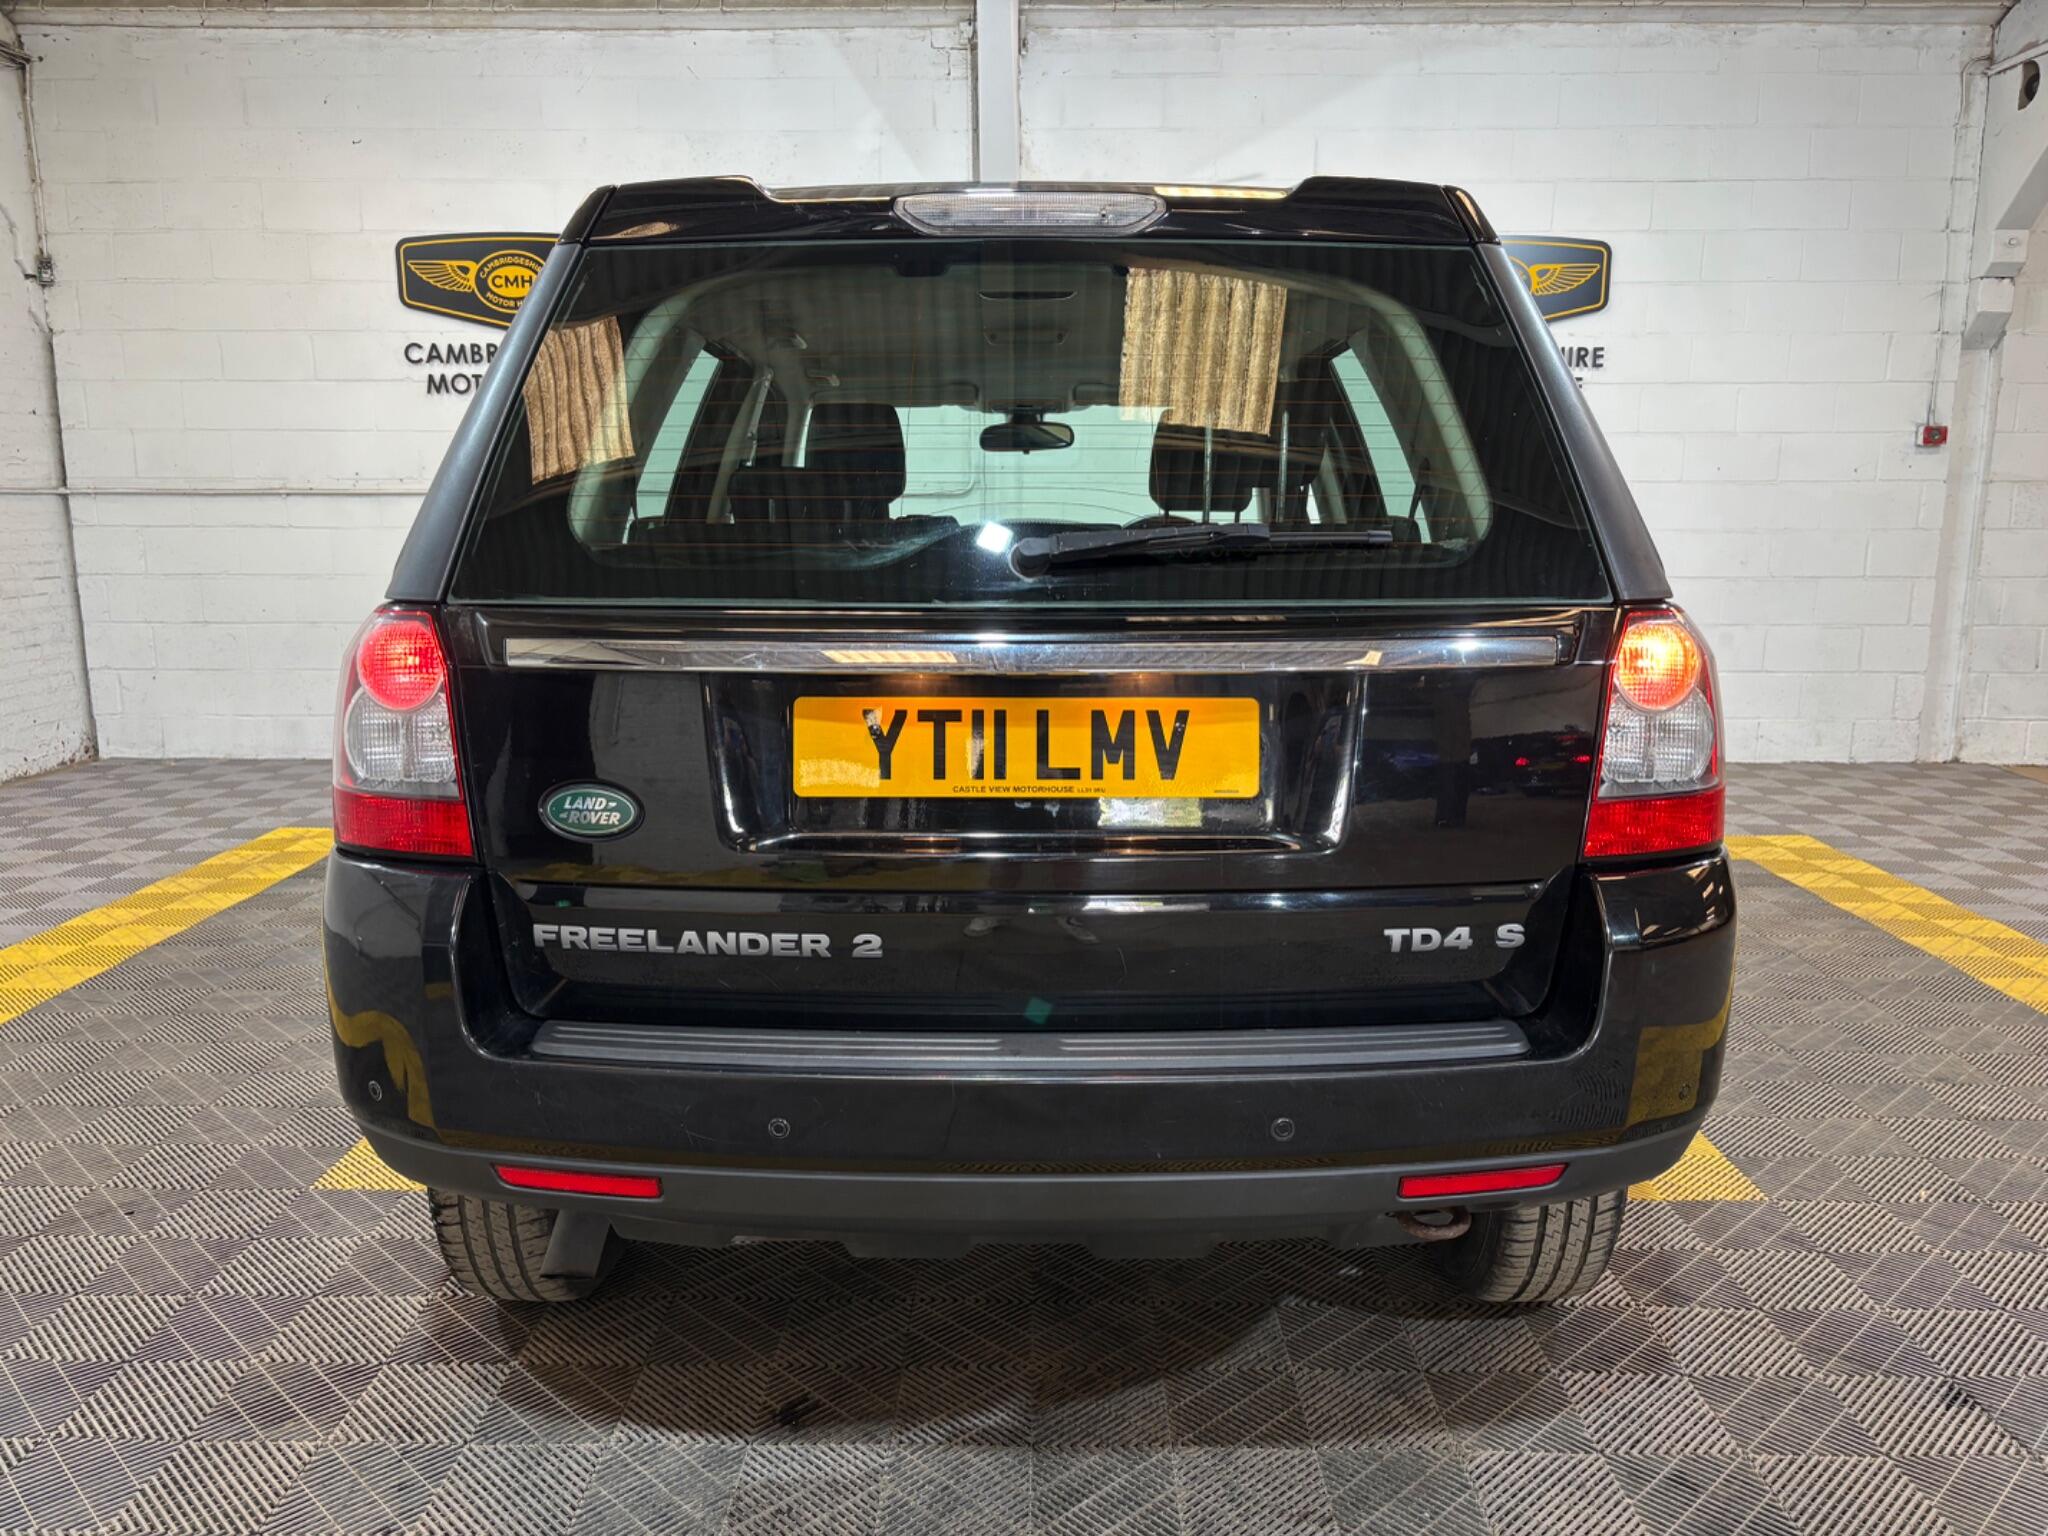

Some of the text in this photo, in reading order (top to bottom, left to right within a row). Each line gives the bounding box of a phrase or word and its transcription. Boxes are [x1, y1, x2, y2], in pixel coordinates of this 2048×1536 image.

[491, 274, 533, 289] CMH
[486, 291, 516, 307] MOTOR
[404, 342, 498, 364] CAMBR
[427, 373, 483, 395] MOT
[1036, 709, 1190, 780] LMV
[952, 785, 986, 793] CASTLE
[988, 785, 1011, 793] VIEW
[1012, 785, 1074, 793] MOTORHOUSE
[563, 796, 608, 810] LAND
[567, 810, 621, 825] ROVER
[533, 923, 884, 958] FREELANDER 2
[1383, 923, 1526, 953] TD4 S
